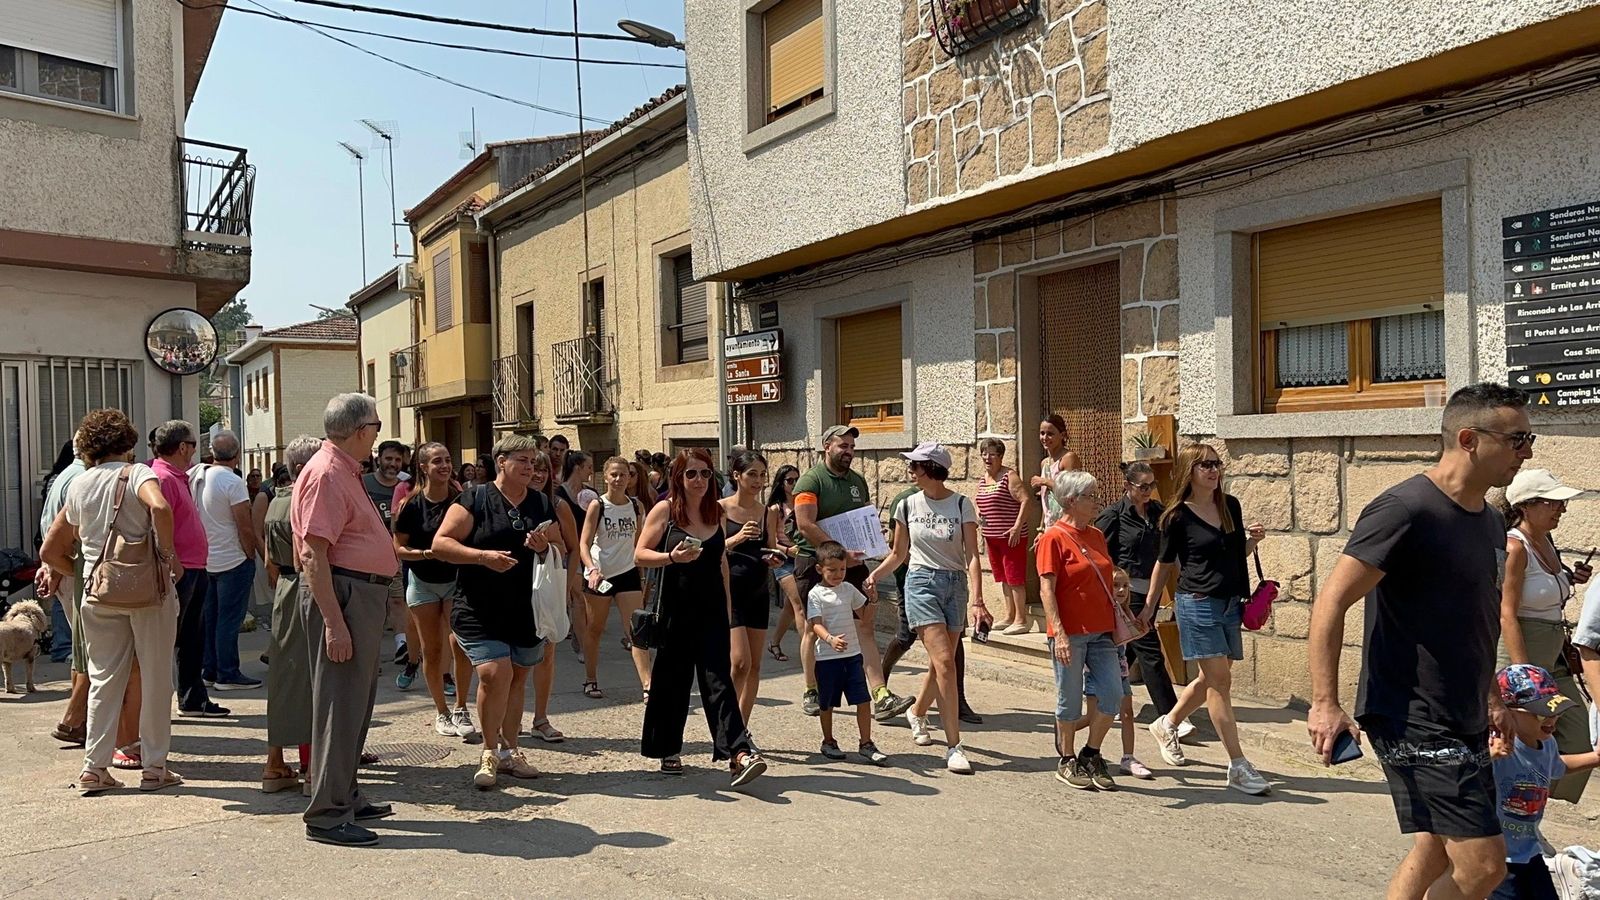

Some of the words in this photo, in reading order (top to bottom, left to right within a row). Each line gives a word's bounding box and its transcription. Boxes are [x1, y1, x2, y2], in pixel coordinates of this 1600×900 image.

[1549, 209, 1585, 220] Senderos
[1550, 232, 1586, 242] Senderos
[1550, 254, 1590, 265] Miradores
[1551, 281, 1577, 291] Ermita
[1579, 279, 1589, 287] de
[1517, 306, 1556, 317] Rinconada
[1557, 305, 1568, 313] de
[1525, 330, 1532, 338] El
[1534, 327, 1557, 337] Portal
[1559, 326, 1569, 335] de
[1571, 325, 1584, 334] Las
[1563, 349, 1583, 357] Casa
[727, 370, 733, 379] La
[735, 369, 750, 378] Santa
[1556, 371, 1577, 381] Cruz
[1579, 369, 1593, 379] del
[735, 393, 758, 402] Salvador
[1557, 388, 1591, 398] Camping
[1557, 398, 1567, 406] de
[1569, 397, 1580, 405] las
